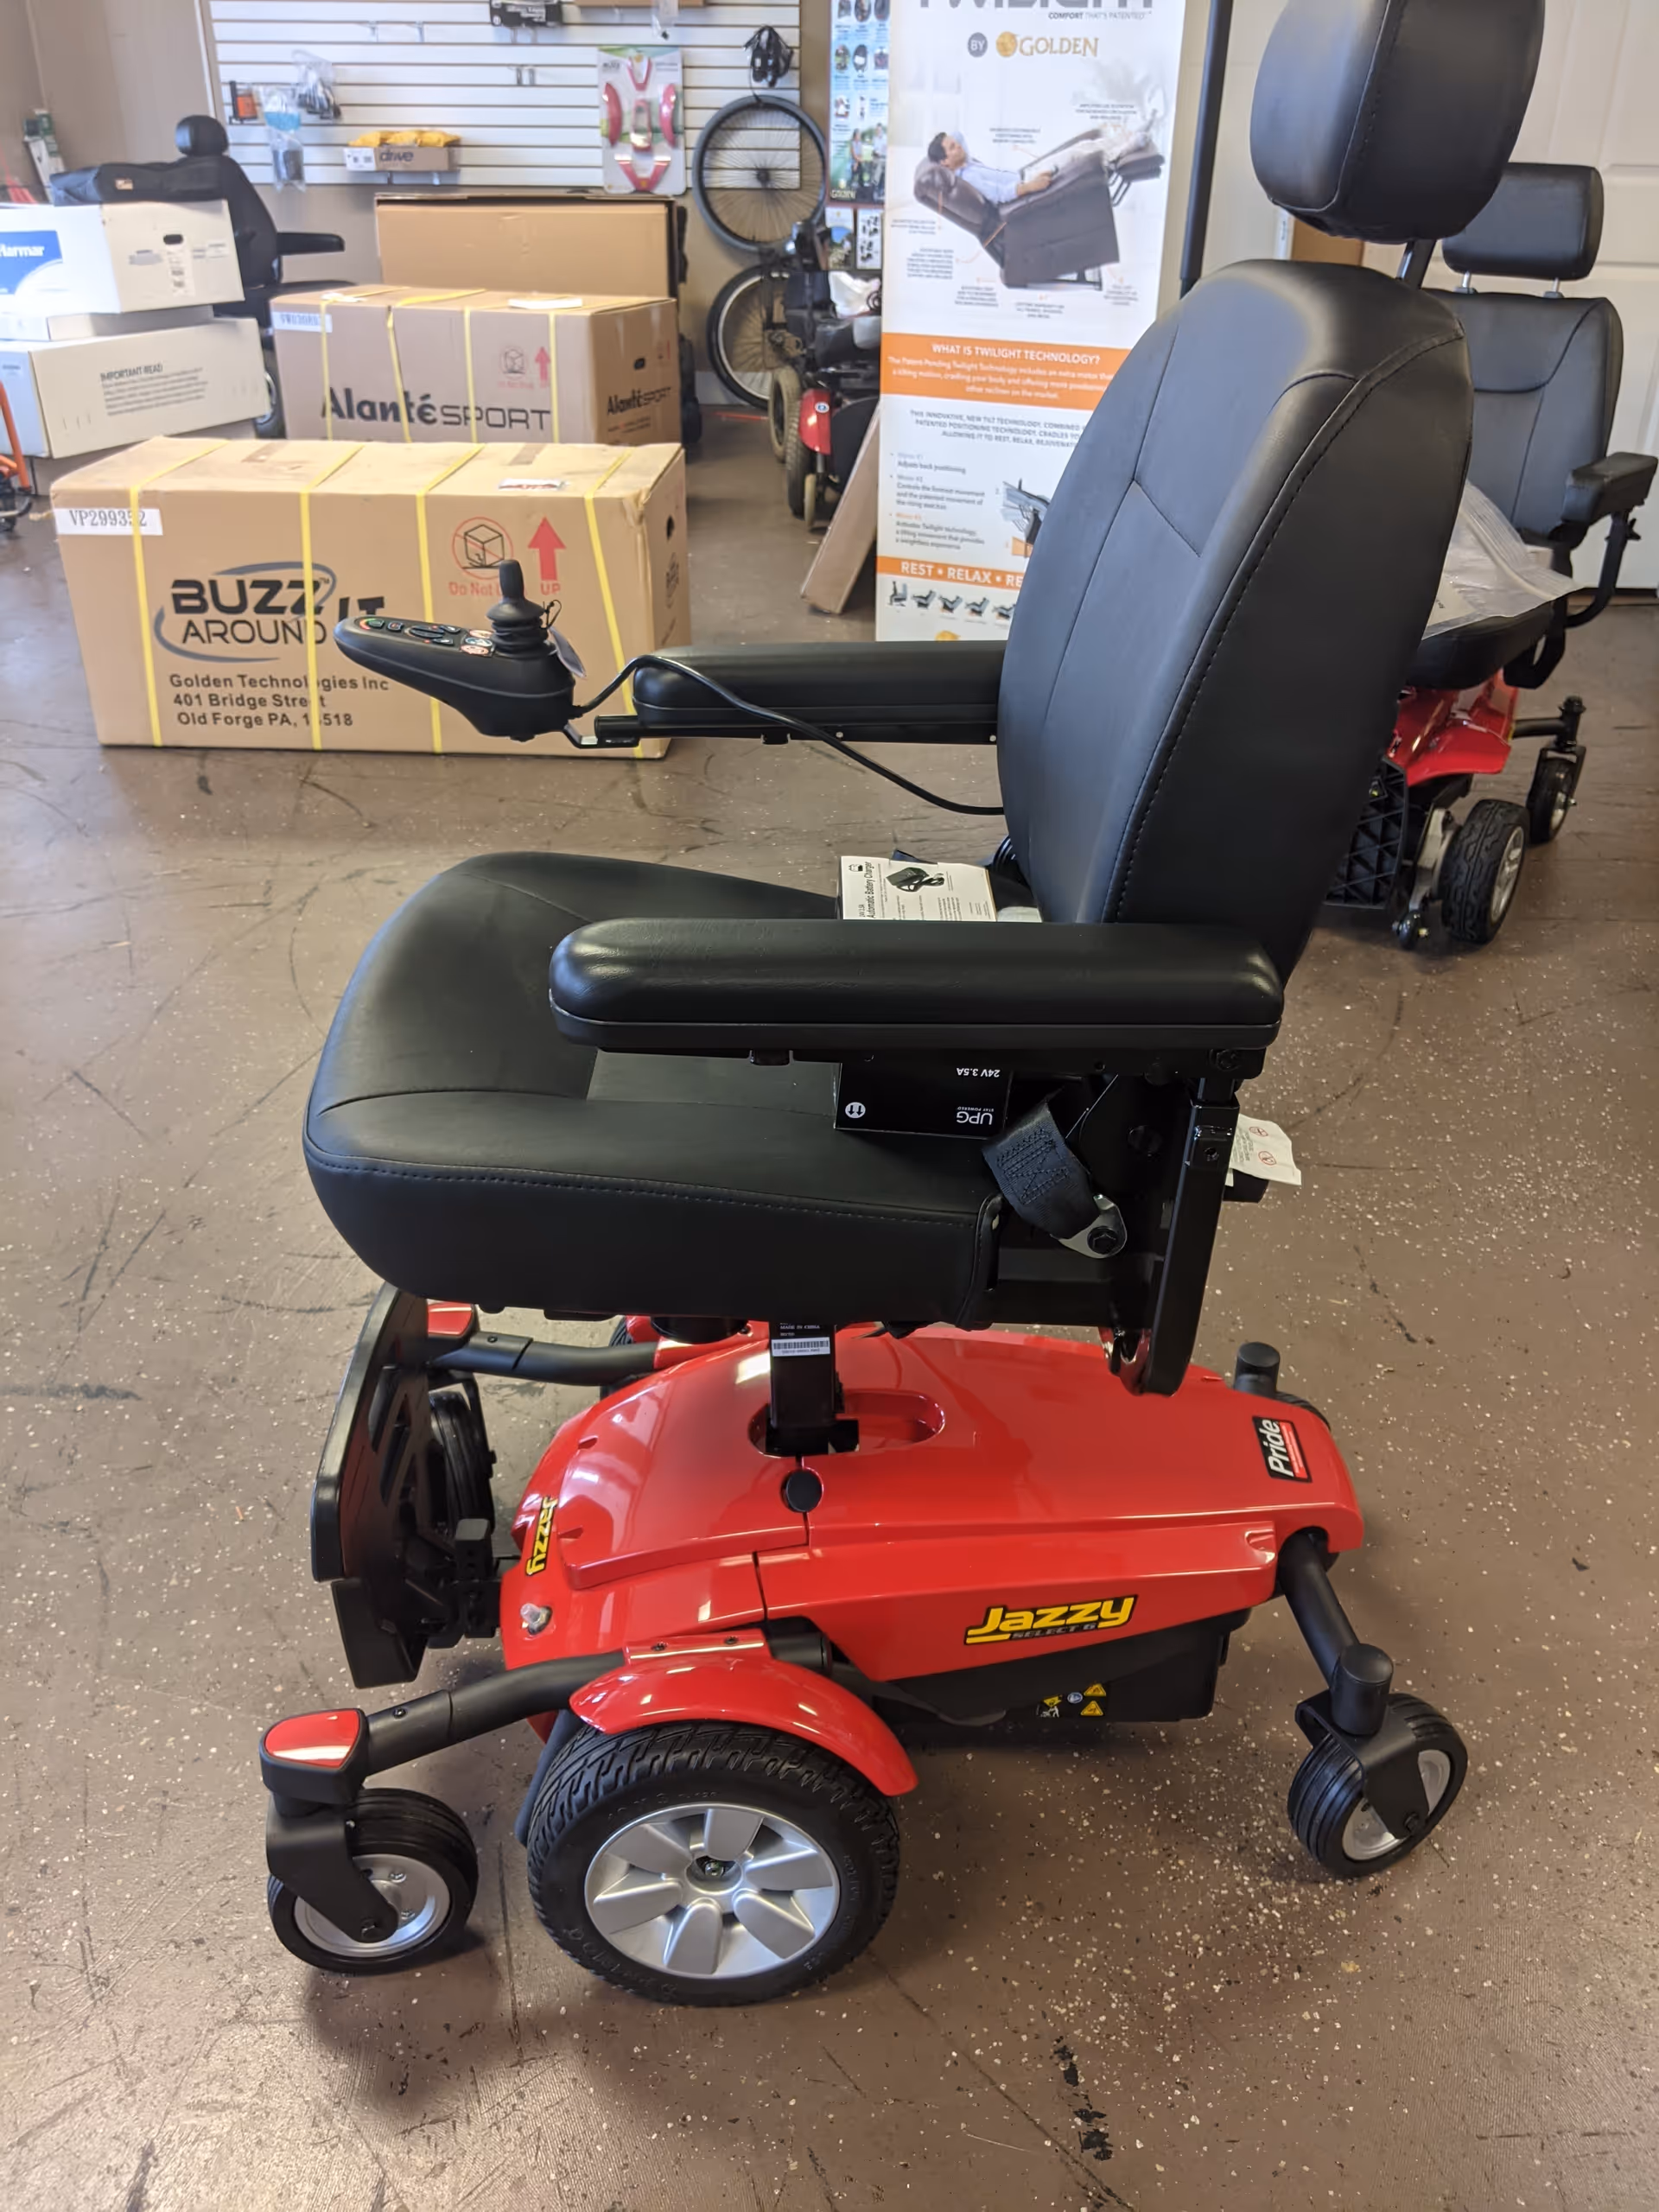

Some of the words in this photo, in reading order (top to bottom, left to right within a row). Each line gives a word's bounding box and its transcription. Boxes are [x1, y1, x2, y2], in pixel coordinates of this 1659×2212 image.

[970, 40, 985, 51] BY
[1019, 37, 1100, 57] GOLDEN
[380, 148, 414, 162] drive
[931, 343, 961, 354] WHAT
[963, 346, 972, 355] IS
[975, 347, 1020, 359] TWILIGHT
[1024, 350, 1100, 364] TECHNOLOGY?
[321, 386, 437, 425] Alanté
[68, 509, 147, 527] VP29932
[901, 561, 934, 577] REST
[947, 567, 992, 584] RELAX
[1006, 575, 1024, 588] RE
[170, 580, 325, 615] BUZZ
[448, 582, 467, 596] Do
[470, 582, 493, 596] Not
[540, 582, 561, 596] UP
[182, 620, 327, 645] AROUND
[170, 673, 233, 688] Golden
[238, 674, 358, 692] Technolgies
[363, 677, 390, 690] Inc
[174, 693, 203, 707] 401
[209, 693, 268, 710] Bridge
[272, 694, 326, 708] Stret
[177, 712, 207, 726] Old
[213, 712, 264, 729] Forge
[268, 713, 297, 728] PA,
[302, 713, 353, 727] 1518
[864, 861, 874, 878] Charger
[864, 879, 875, 895] Battery
[865, 895, 876, 918] Automatic
[957, 1067, 979, 1077] 3.5A
[981, 1068, 1001, 1077] 24V
[957, 1111, 993, 1125] UPG
[1259, 1419, 1294, 1477] Pride
[526, 1497, 558, 1575] Jazzy
[966, 1597, 1135, 1642] Jazzy
[1011, 1624, 1078, 1639] SELECT
[1083, 1622, 1096, 1630] 6
